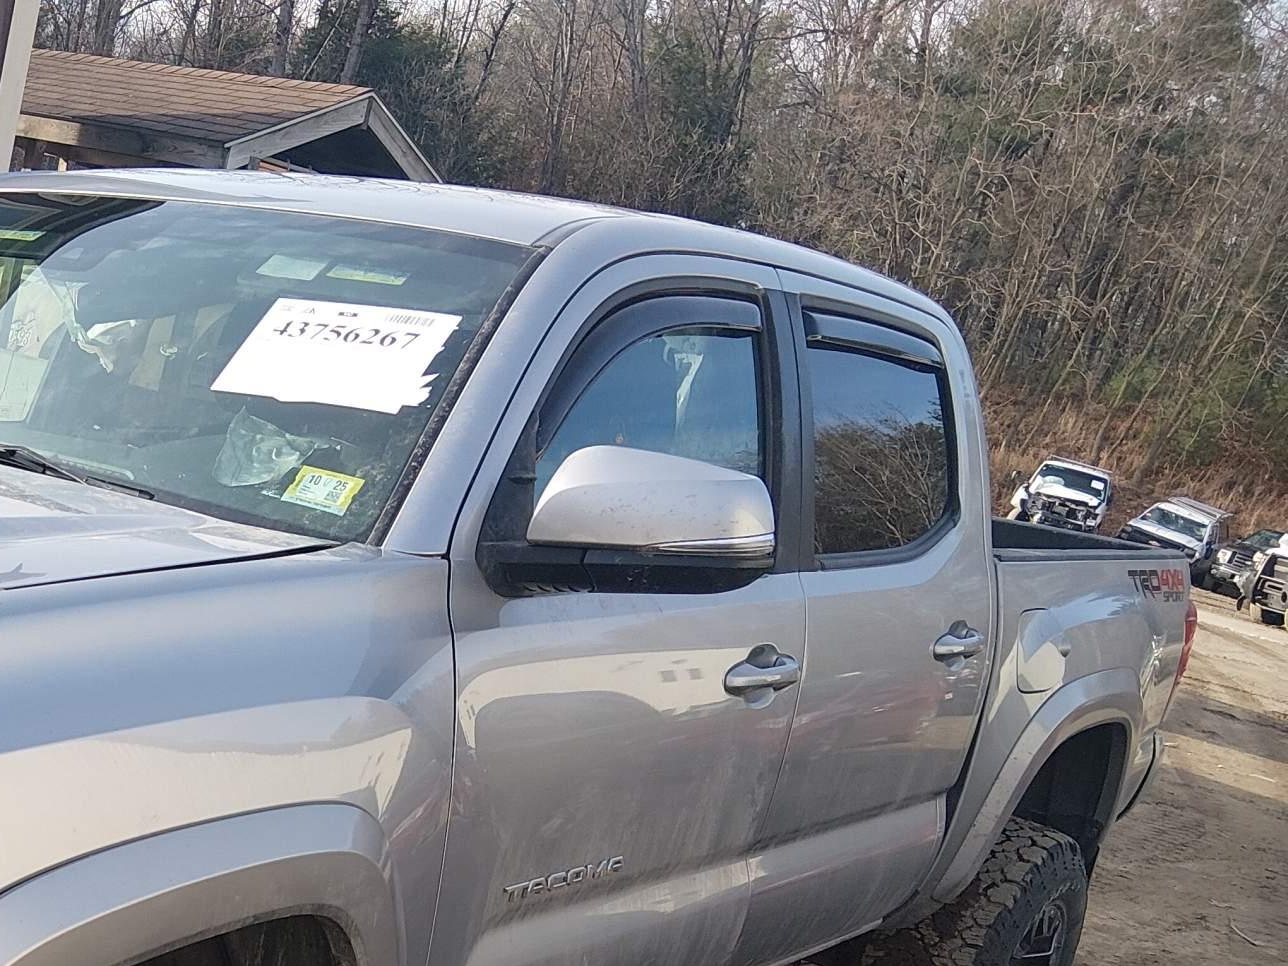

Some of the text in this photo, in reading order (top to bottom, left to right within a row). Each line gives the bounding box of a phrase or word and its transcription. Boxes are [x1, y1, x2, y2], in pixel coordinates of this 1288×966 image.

[273, 319, 421, 349] 43756267
[308, 474, 349, 492] 10 25
[1127, 569, 1160, 599] TRD
[504, 855, 624, 902] TACOMA
